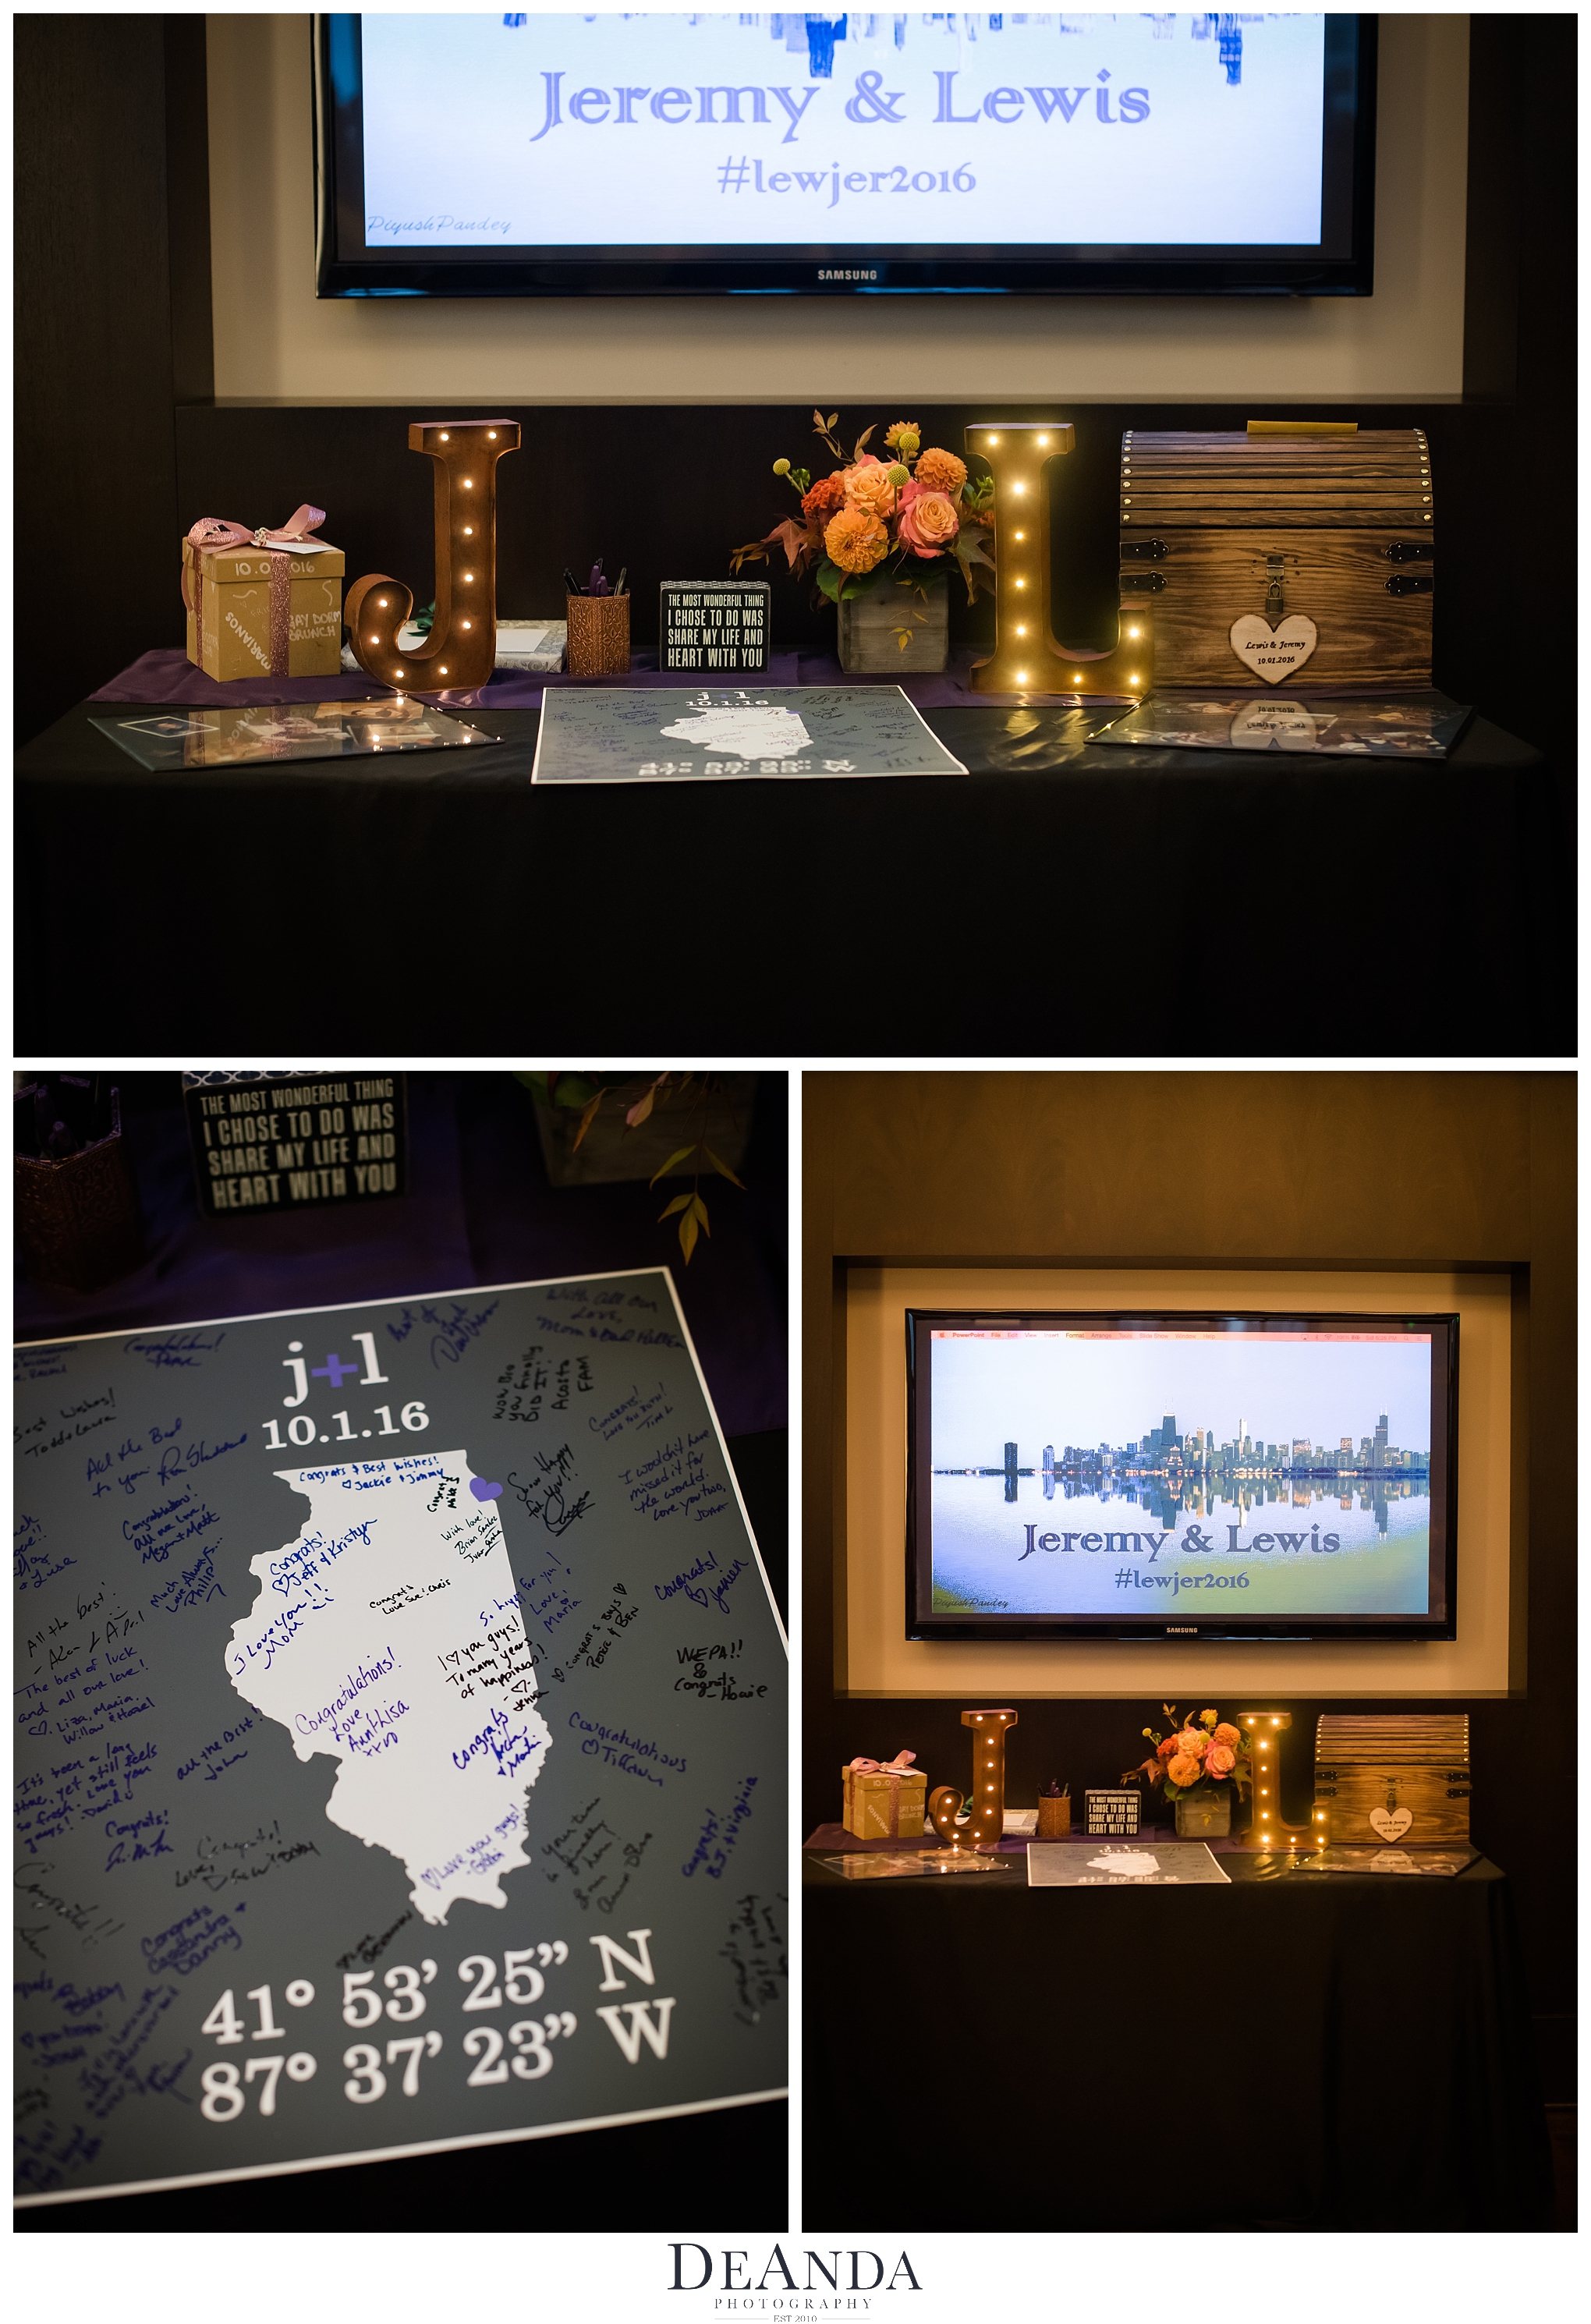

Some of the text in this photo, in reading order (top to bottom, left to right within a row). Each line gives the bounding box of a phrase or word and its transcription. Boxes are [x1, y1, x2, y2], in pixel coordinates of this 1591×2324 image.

[530, 68, 1151, 144] Jeremy & Lewis
[717, 155, 977, 209] #lewjer2016
[817, 269, 878, 281] SAMSUNG
[668, 594, 764, 607] THE MOST WONDERFUL THING
[668, 609, 764, 626] I CHOSE TO DO WAS
[225, 611, 271, 670] MARIANOS
[668, 628, 764, 645] SHARE MY LIFE AND
[1245, 641, 1269, 650] Lewis
[1279, 641, 1306, 650] Jeremy
[668, 648, 763, 667] HEART WITH YOU
[200, 1078, 394, 1116] THE MOST WONDERFUL THING
[203, 1103, 395, 1147] I CHOSE TO DO WAS
[207, 1133, 395, 1177] SHARE MY LIFE AND
[211, 1162, 397, 1210] HEART WITH YOU
[262, 1401, 430, 1450] 10.1.16
[363, 1461, 386, 1474] Best
[354, 1474, 392, 1491] Jackie
[441, 1525, 464, 1541] With
[1018, 1522, 1341, 1563] Jeremy & Lewis
[288, 1561, 319, 1586] Jeff
[1114, 1568, 1250, 1596] #lewjer2016
[1089, 1804, 1138, 1813] I CHOSE TO DO WAS
[1089, 1814, 1138, 1823] SHARE MY LIFE AND
[1089, 1823, 1138, 1833] HEART WITH YOU
[589, 1929, 656, 1993] N
[596, 1996, 676, 2064] W
